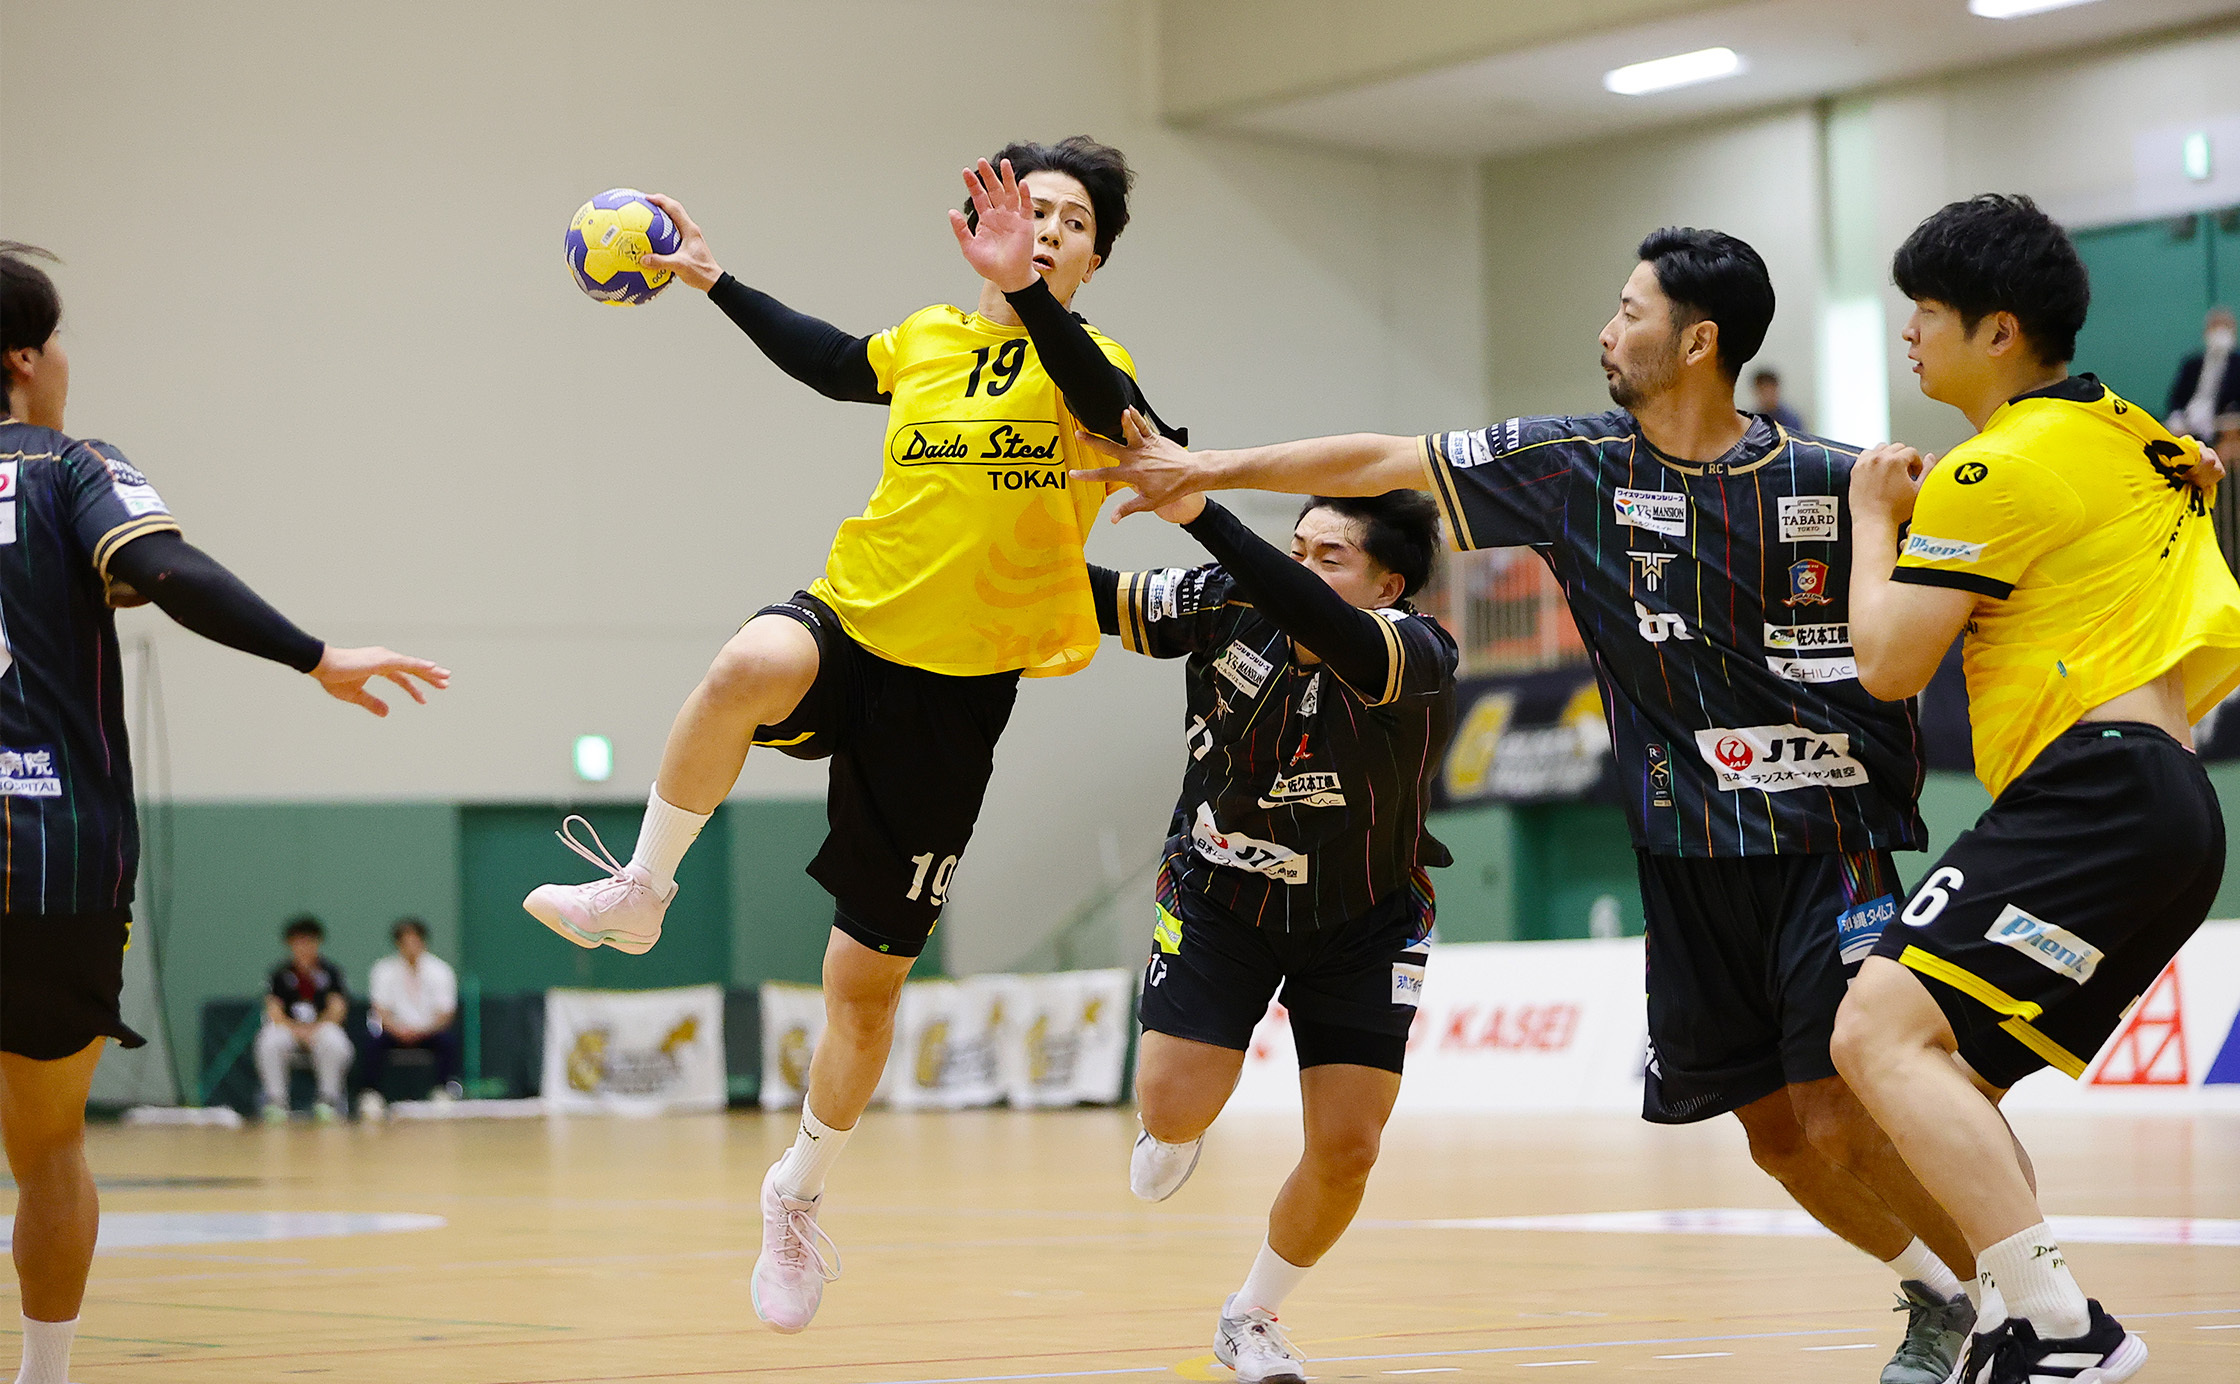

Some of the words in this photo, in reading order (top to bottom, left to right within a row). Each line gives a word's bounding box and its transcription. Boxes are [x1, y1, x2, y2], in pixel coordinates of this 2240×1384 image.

[965, 338, 1029, 397] 19
[901, 429, 968, 461] Daido
[980, 424, 1059, 460] Steel
[1708, 463, 1723, 474] RC
[987, 470, 1066, 490] TOKAI
[1652, 506, 1684, 518] MANSION
[1782, 515, 1835, 526] TABARD
[1790, 665, 1853, 679] SHILAC
[1762, 737, 1840, 762] JTA
[1728, 760, 1748, 768] JAL
[0, 780, 57, 791] OSPITAL
[905, 852, 957, 906] 19
[1900, 866, 1965, 928] 6
